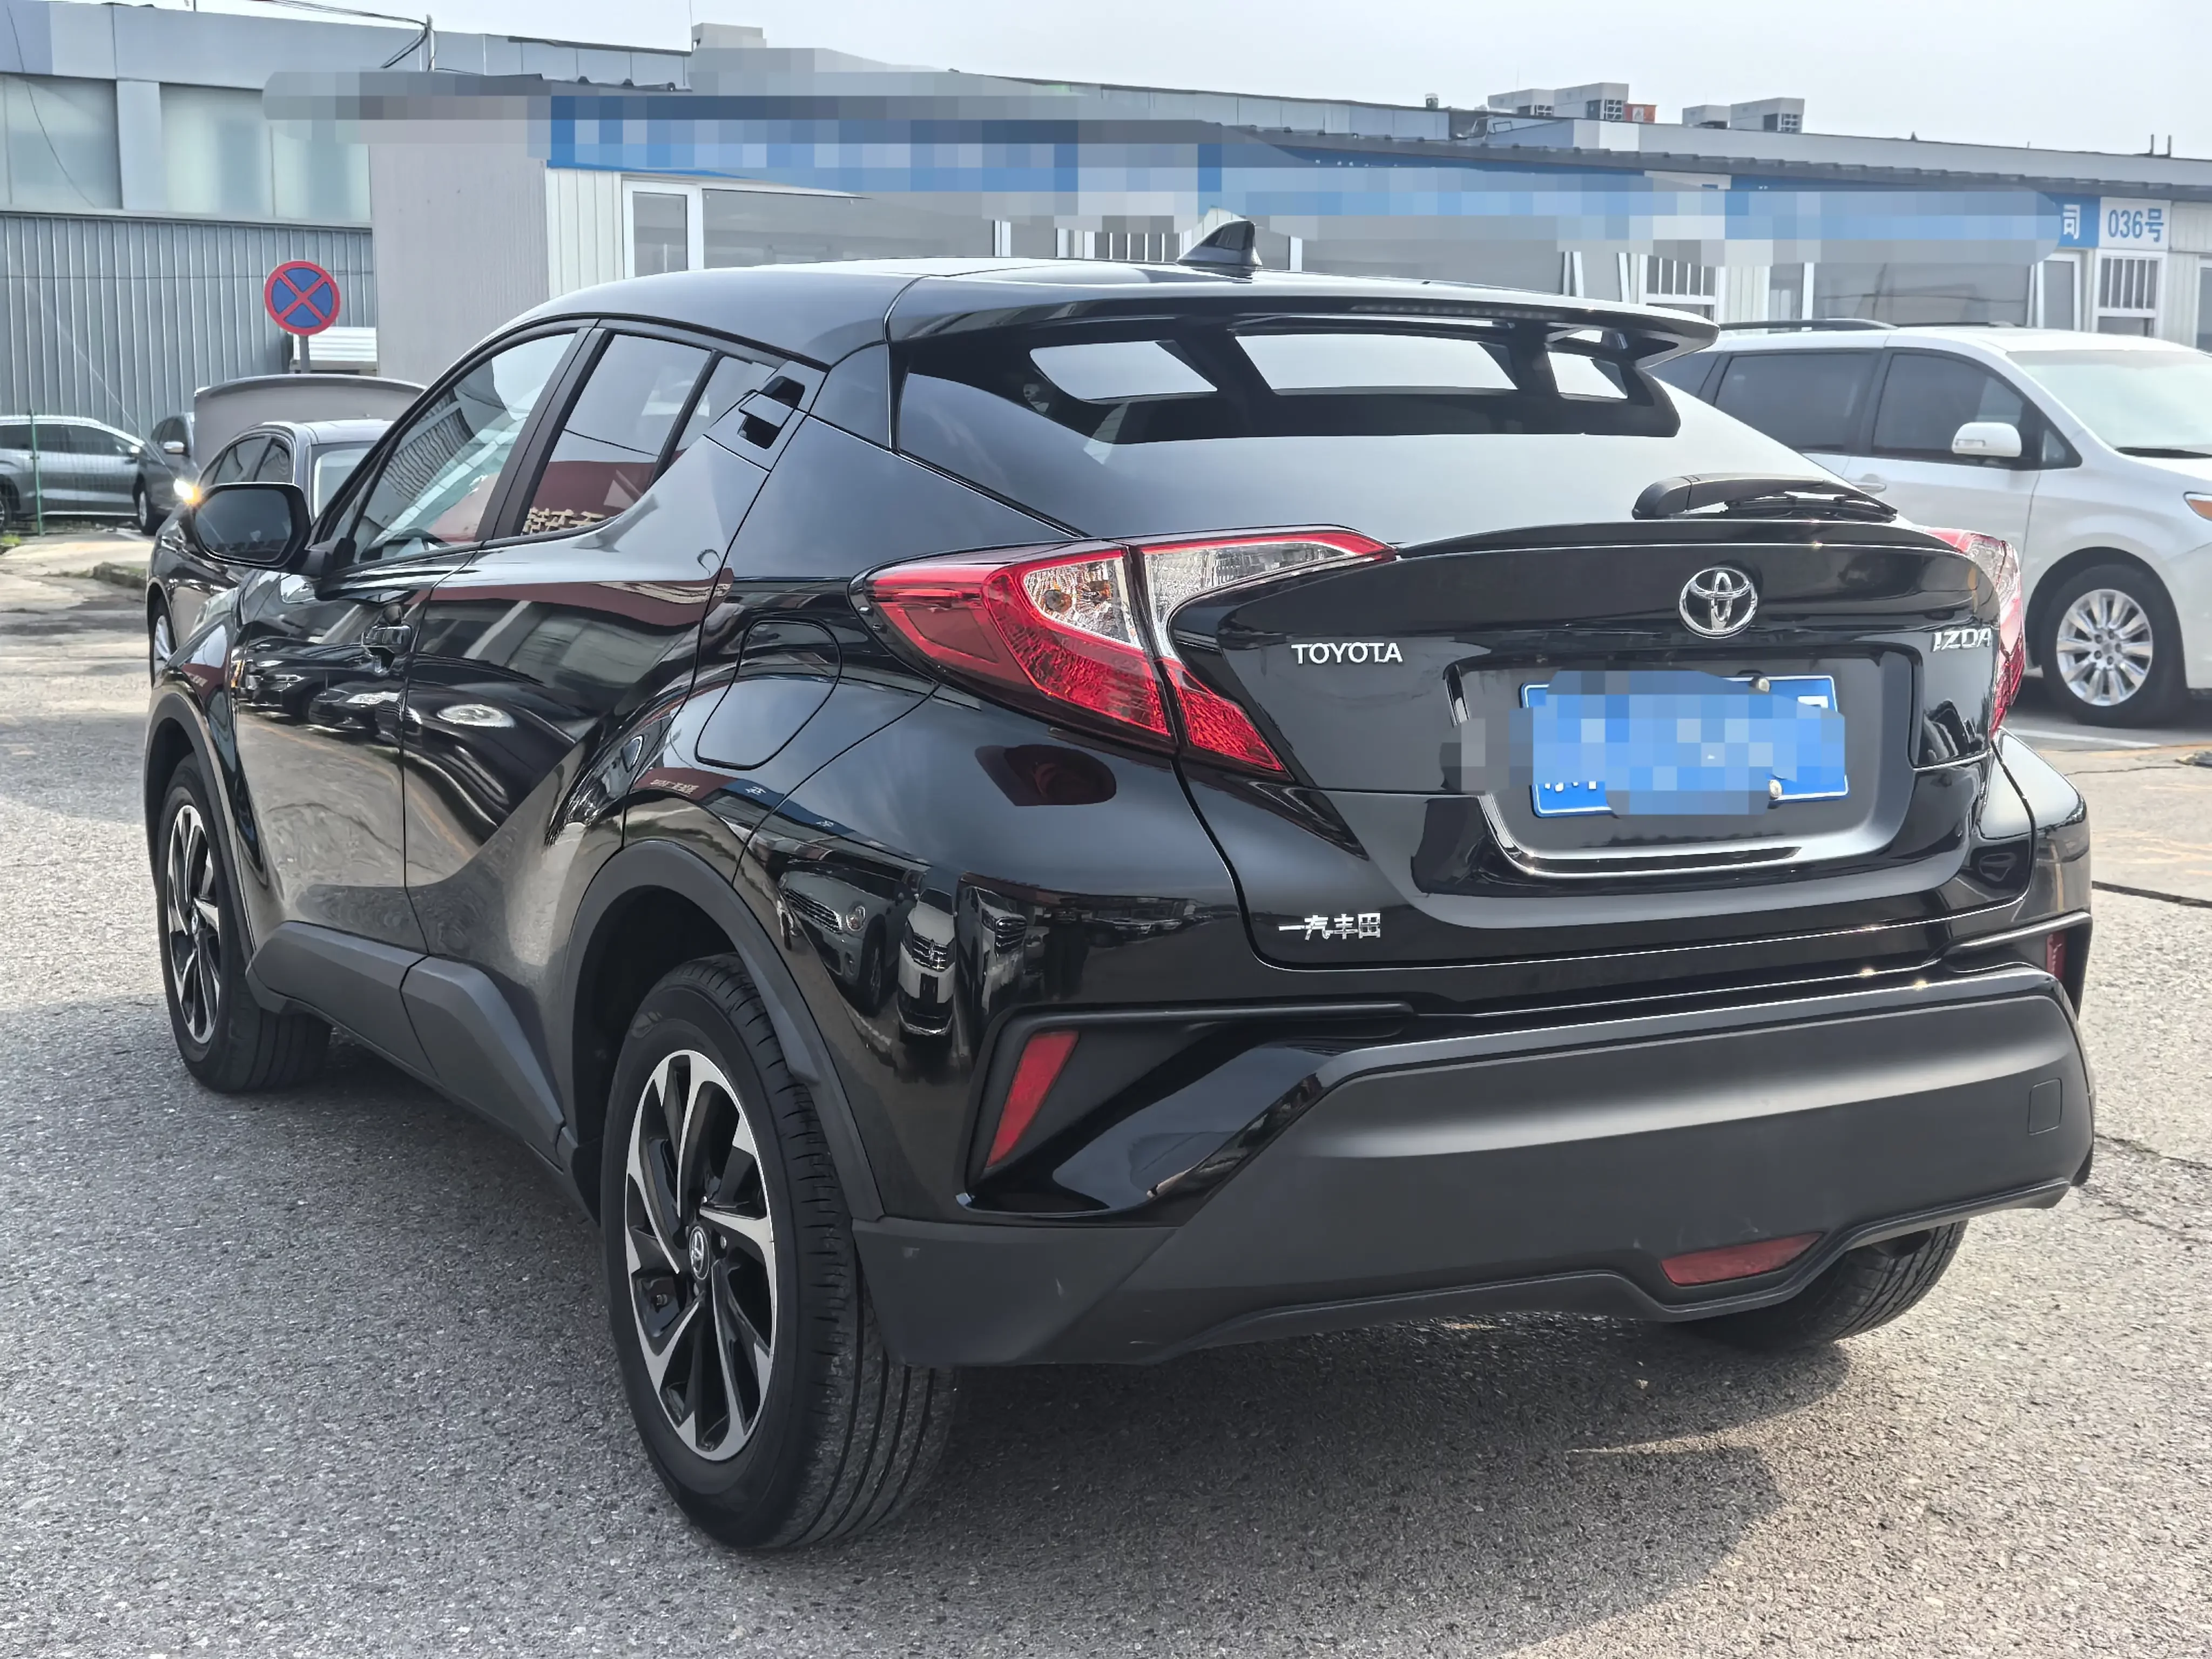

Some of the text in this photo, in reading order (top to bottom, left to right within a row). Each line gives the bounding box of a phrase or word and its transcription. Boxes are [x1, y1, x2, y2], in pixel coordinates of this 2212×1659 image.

[2063, 204, 2081, 240] 司
[2108, 208, 2164, 242] 036号
[1291, 642, 1403, 664] TOYOTA
[1278, 913, 1380, 941] 一汽丰田
